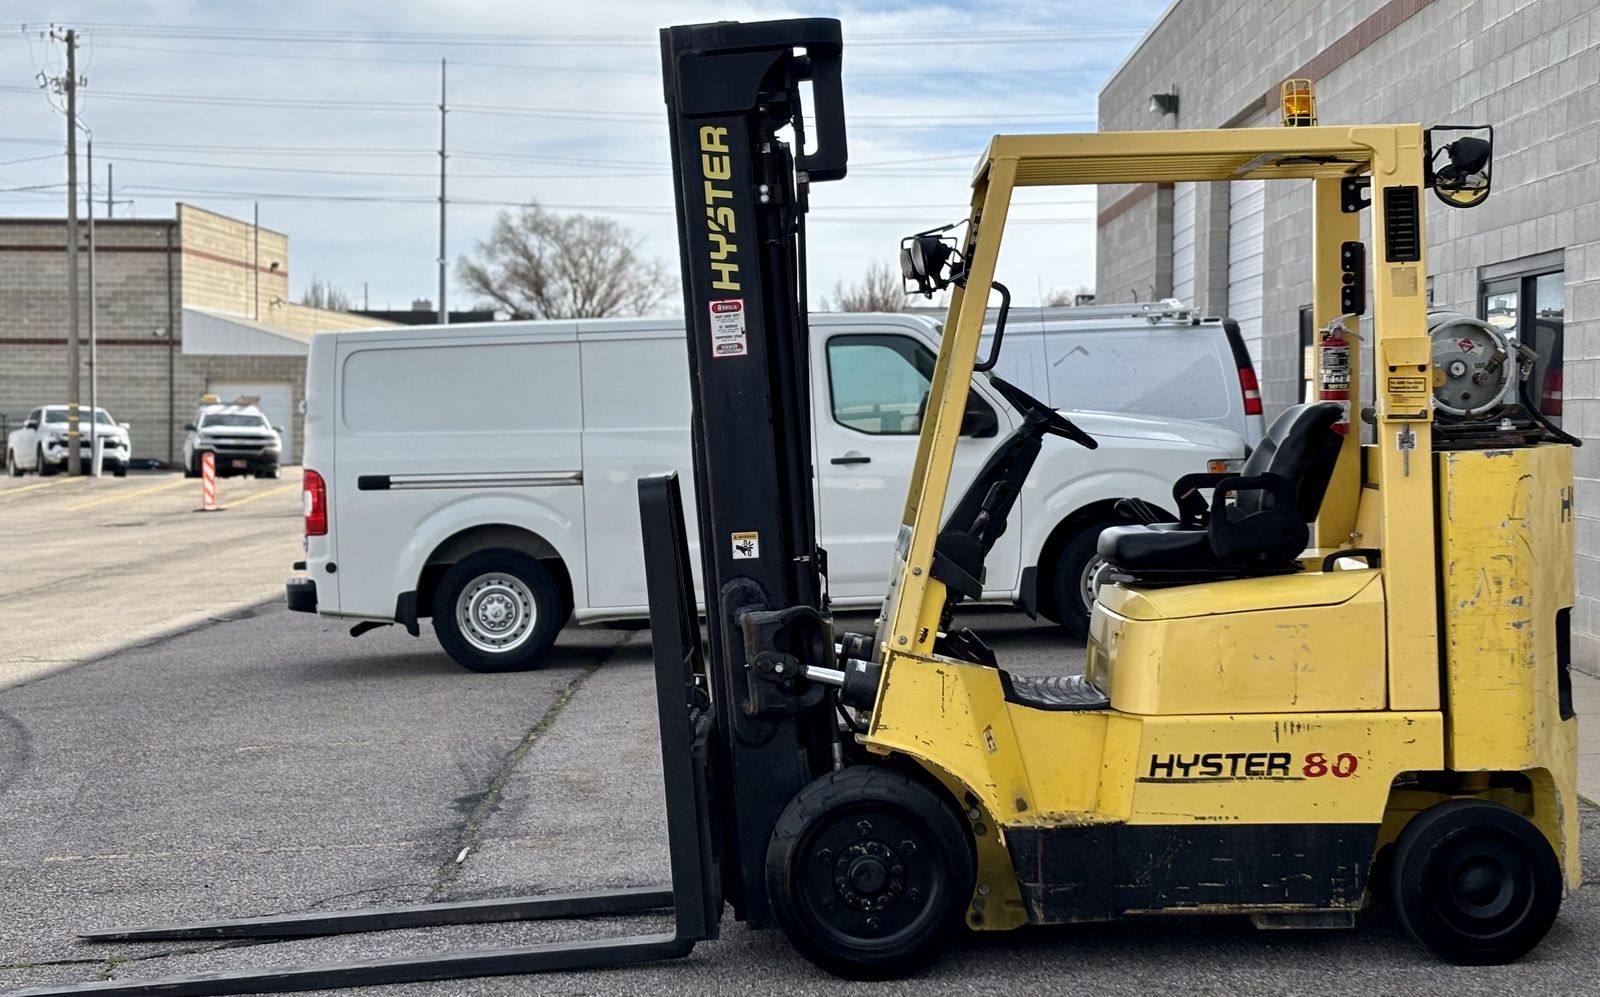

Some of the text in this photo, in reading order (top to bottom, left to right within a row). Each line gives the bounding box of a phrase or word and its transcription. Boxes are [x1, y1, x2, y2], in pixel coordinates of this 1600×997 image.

[700, 125, 741, 291] HYSTER
[1149, 752, 1358, 778] HYSTER 80
